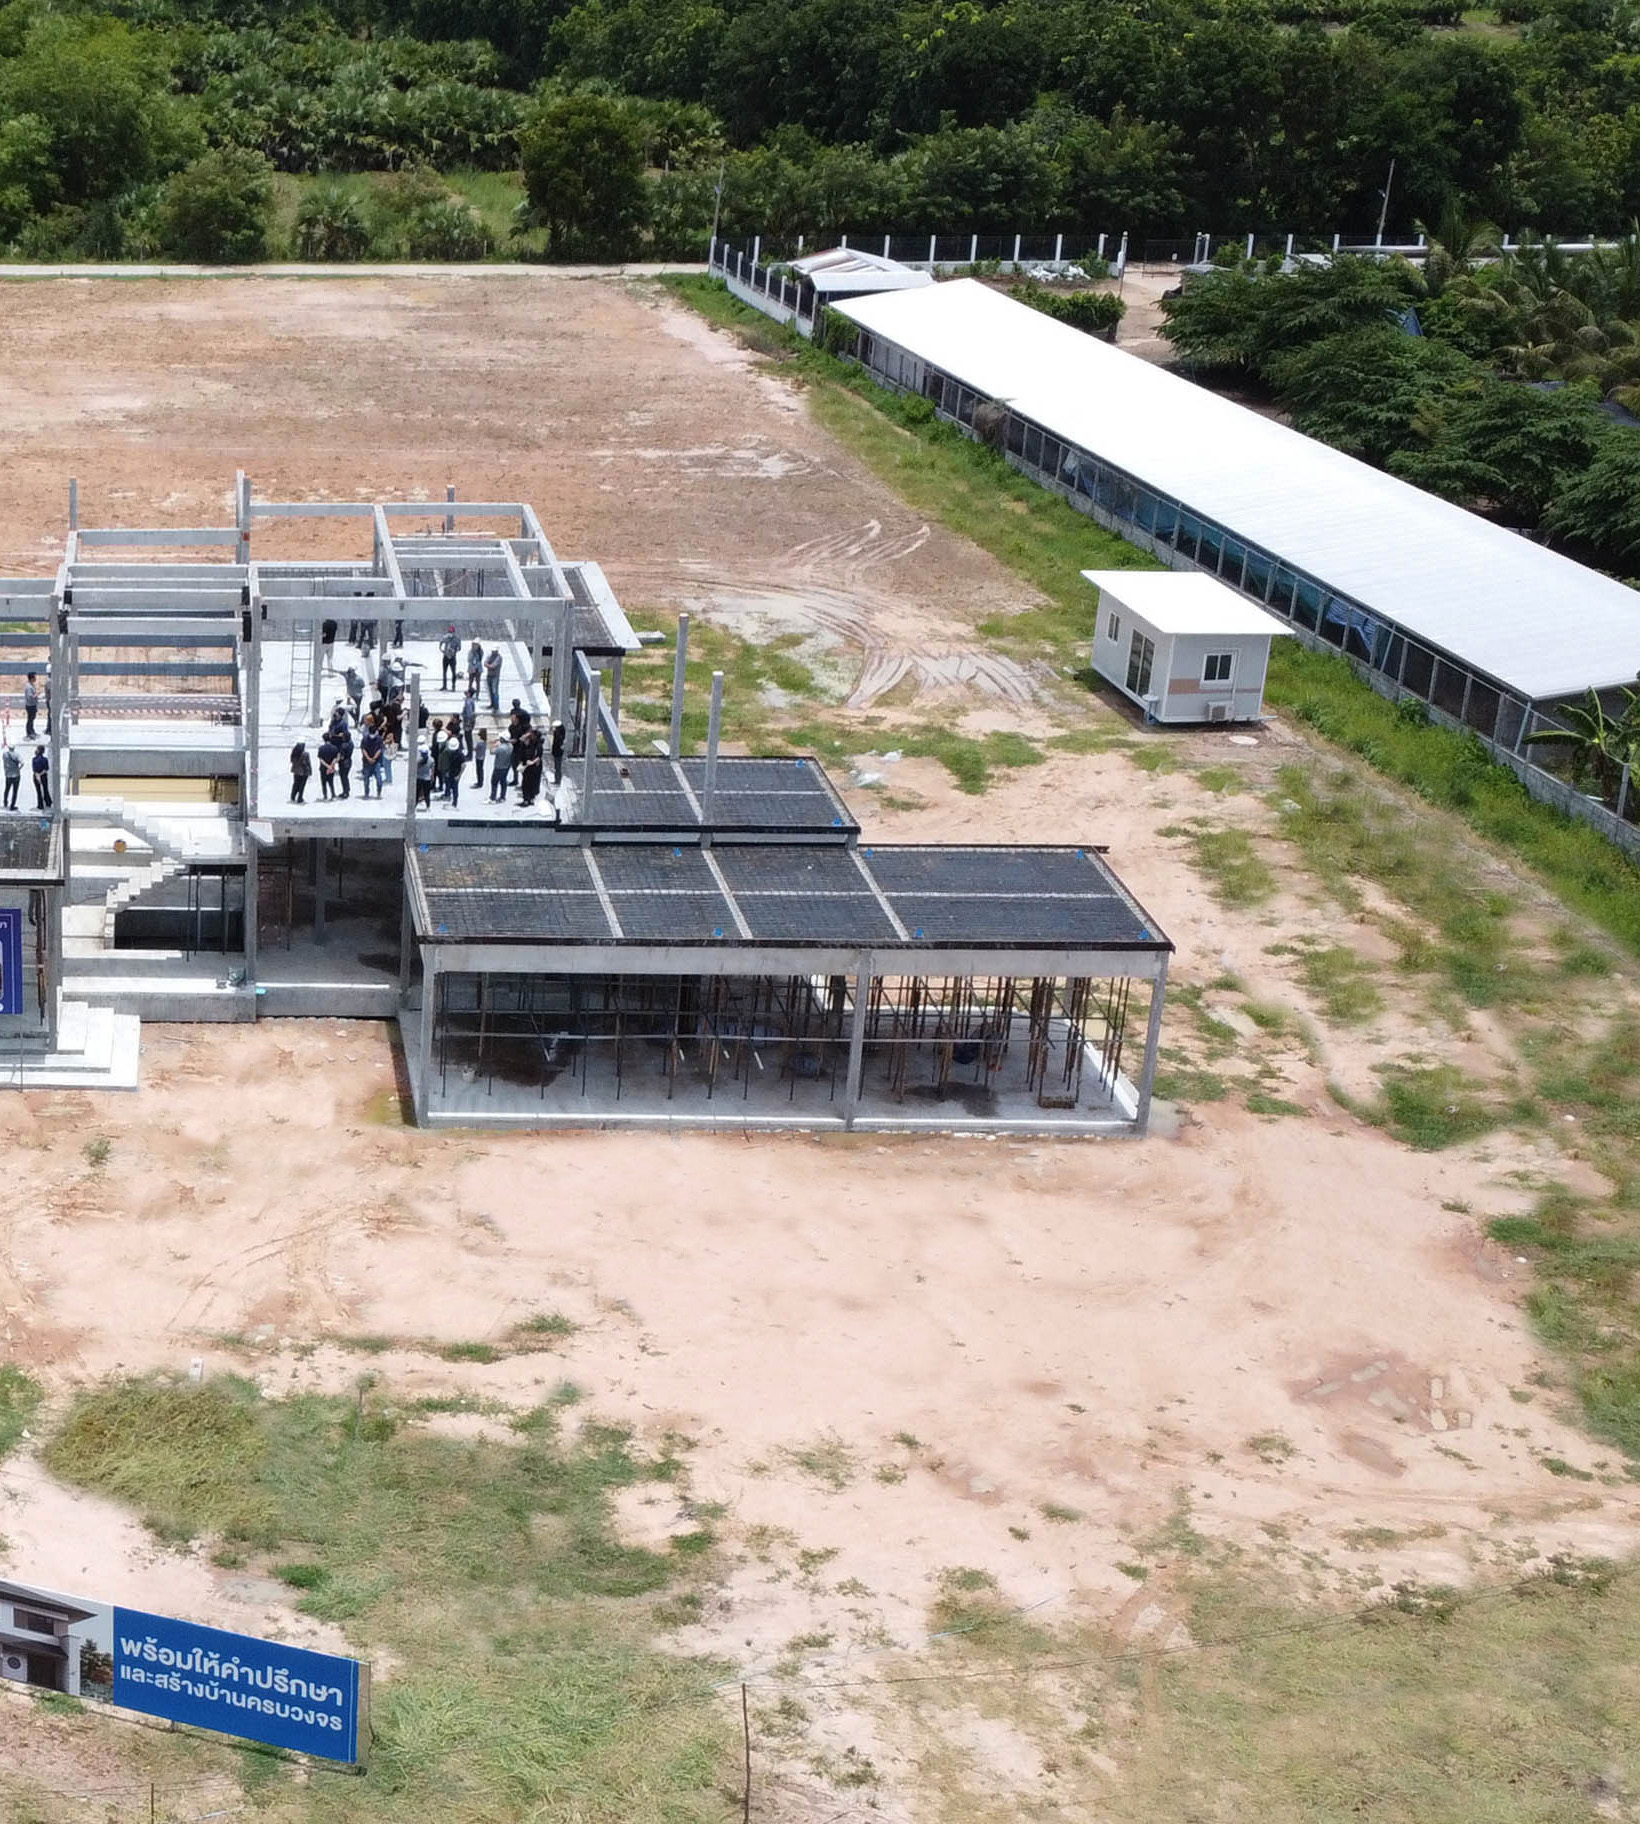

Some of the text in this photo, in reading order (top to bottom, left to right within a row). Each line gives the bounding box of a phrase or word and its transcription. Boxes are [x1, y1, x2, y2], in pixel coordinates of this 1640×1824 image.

[119, 1636, 344, 1707] พร้อมให้คำปรึกษา
[120, 1664, 344, 1732] และสร้างบ้านครบวงจร
